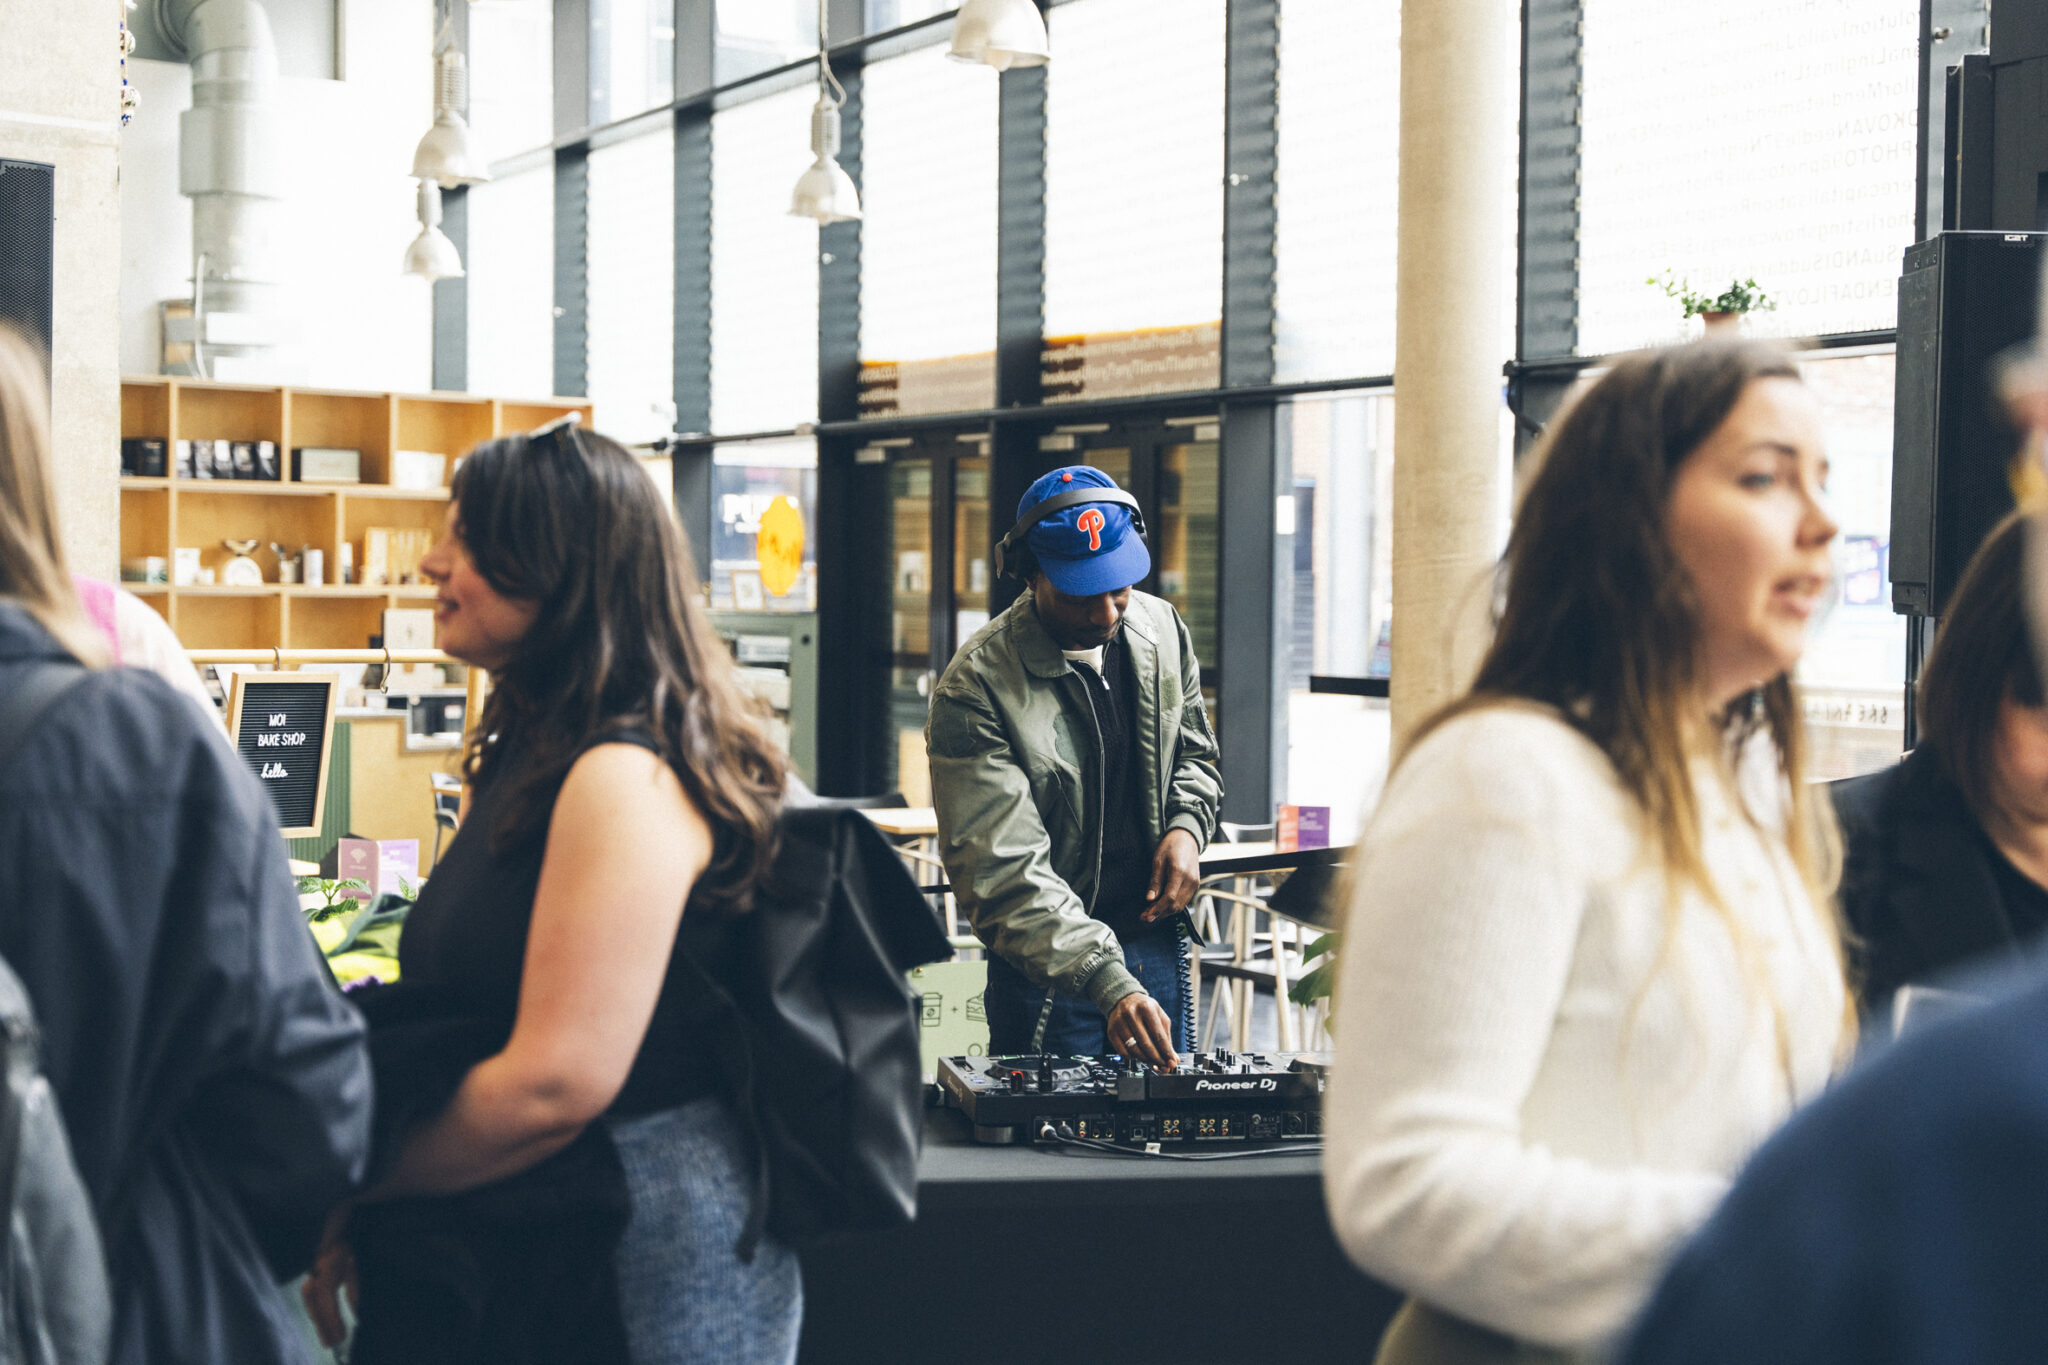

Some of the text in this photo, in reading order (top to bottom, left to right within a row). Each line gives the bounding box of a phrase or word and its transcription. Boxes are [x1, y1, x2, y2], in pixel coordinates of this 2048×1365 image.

[1077, 508, 1106, 552] P
[268, 713, 287, 727] MOI
[257, 732, 306, 747] BAKE SHOP
[260, 762, 288, 779] hello
[1195, 1079, 1257, 1091] Pioneer
